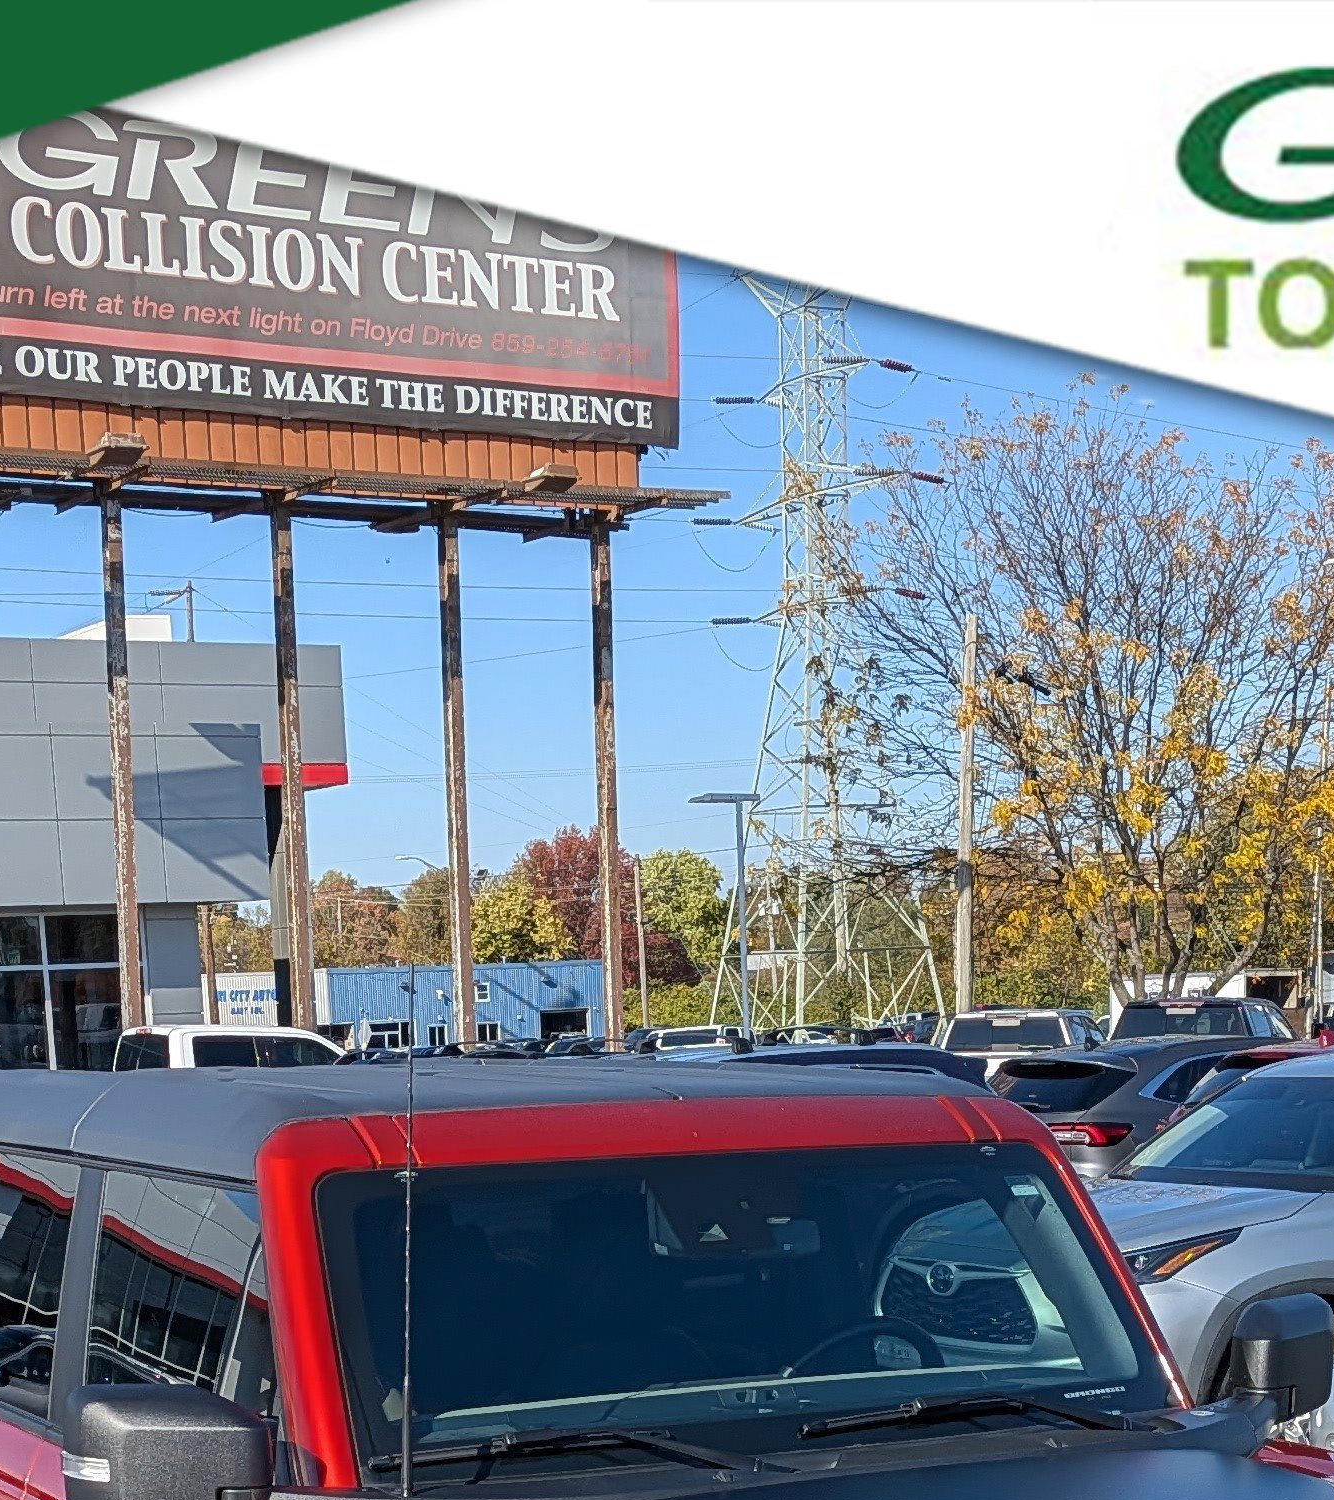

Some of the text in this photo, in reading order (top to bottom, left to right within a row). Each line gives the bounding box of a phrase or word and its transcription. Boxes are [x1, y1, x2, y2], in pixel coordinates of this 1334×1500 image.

[11, 195, 620, 322] COLLISION CENTER
[44, 284, 87, 312] left
[95, 291, 123, 316] at
[132, 295, 175, 321] the
[183, 304, 241, 328] next
[249, 307, 302, 336] light
[310, 318, 341, 337] on
[350, 317, 414, 347] Floyd
[422, 324, 483, 351] Drive
[15, 345, 103, 384] OUR
[112, 354, 253, 397] PEOPLE
[261, 367, 370, 407] MAKE
[375, 377, 445, 414] THE
[453, 384, 654, 430] DIFFERENCE
